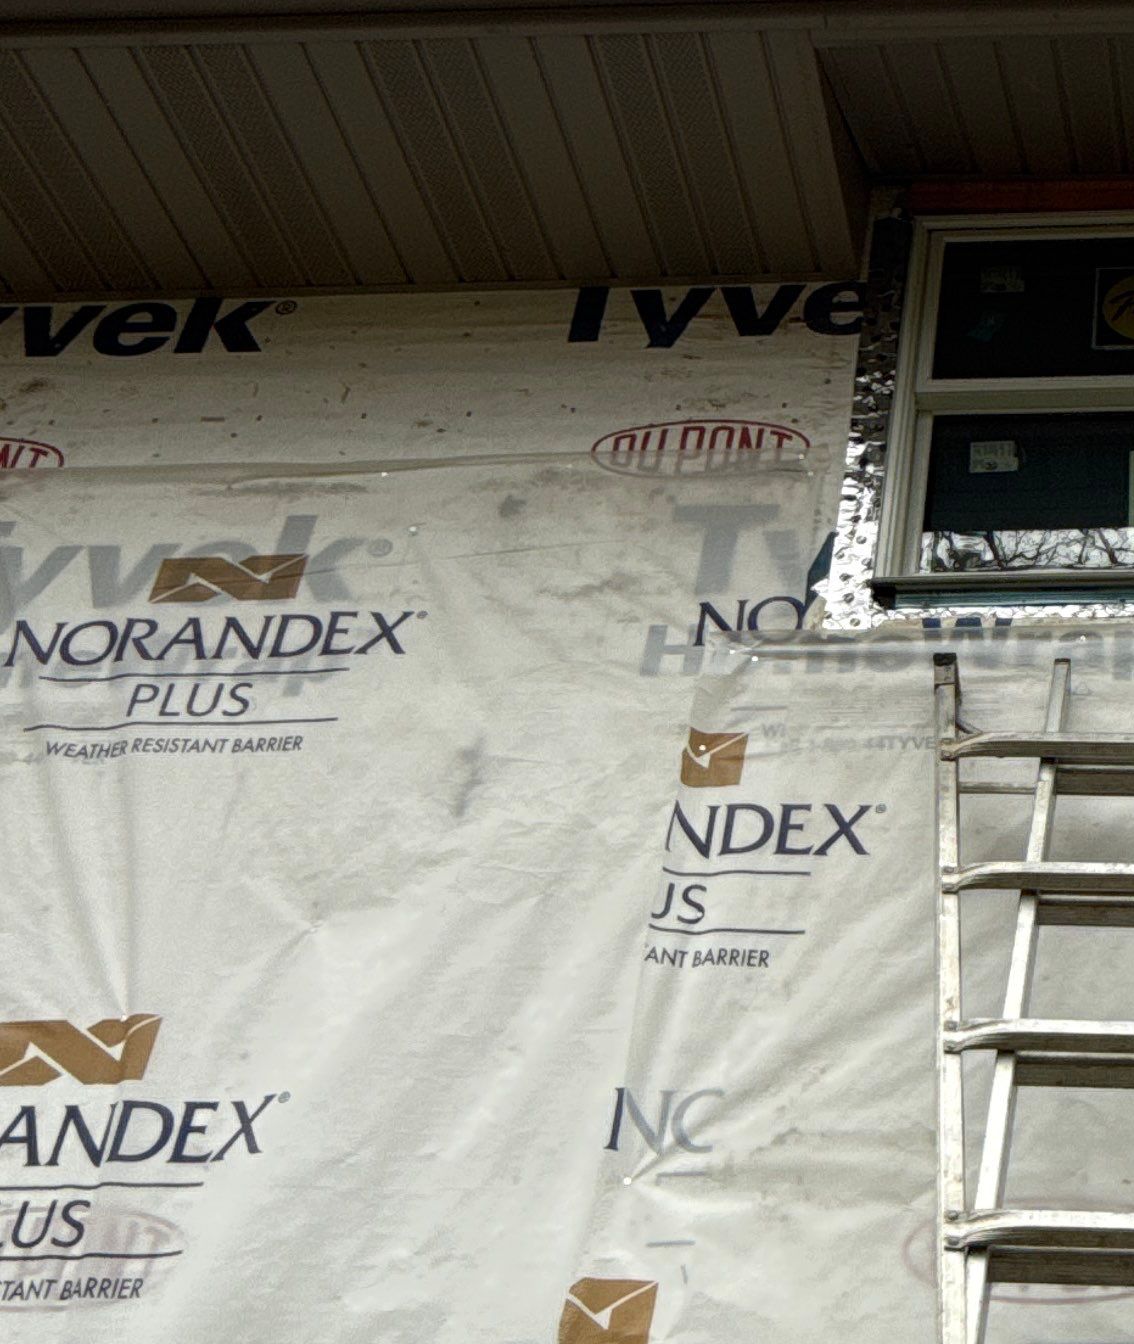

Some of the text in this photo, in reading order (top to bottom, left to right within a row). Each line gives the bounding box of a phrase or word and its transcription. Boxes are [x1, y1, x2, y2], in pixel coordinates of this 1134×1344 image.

[126, 682, 254, 717] PLUS
[46, 740, 129, 759] WEATHER
[131, 736, 228, 754] RESISTANT
[232, 735, 304, 753] BARRIER
[644, 944, 770, 969] ANT BARRIER
[0, 1199, 91, 1249] US
[0, 1277, 144, 1302] TANT BARRIER
